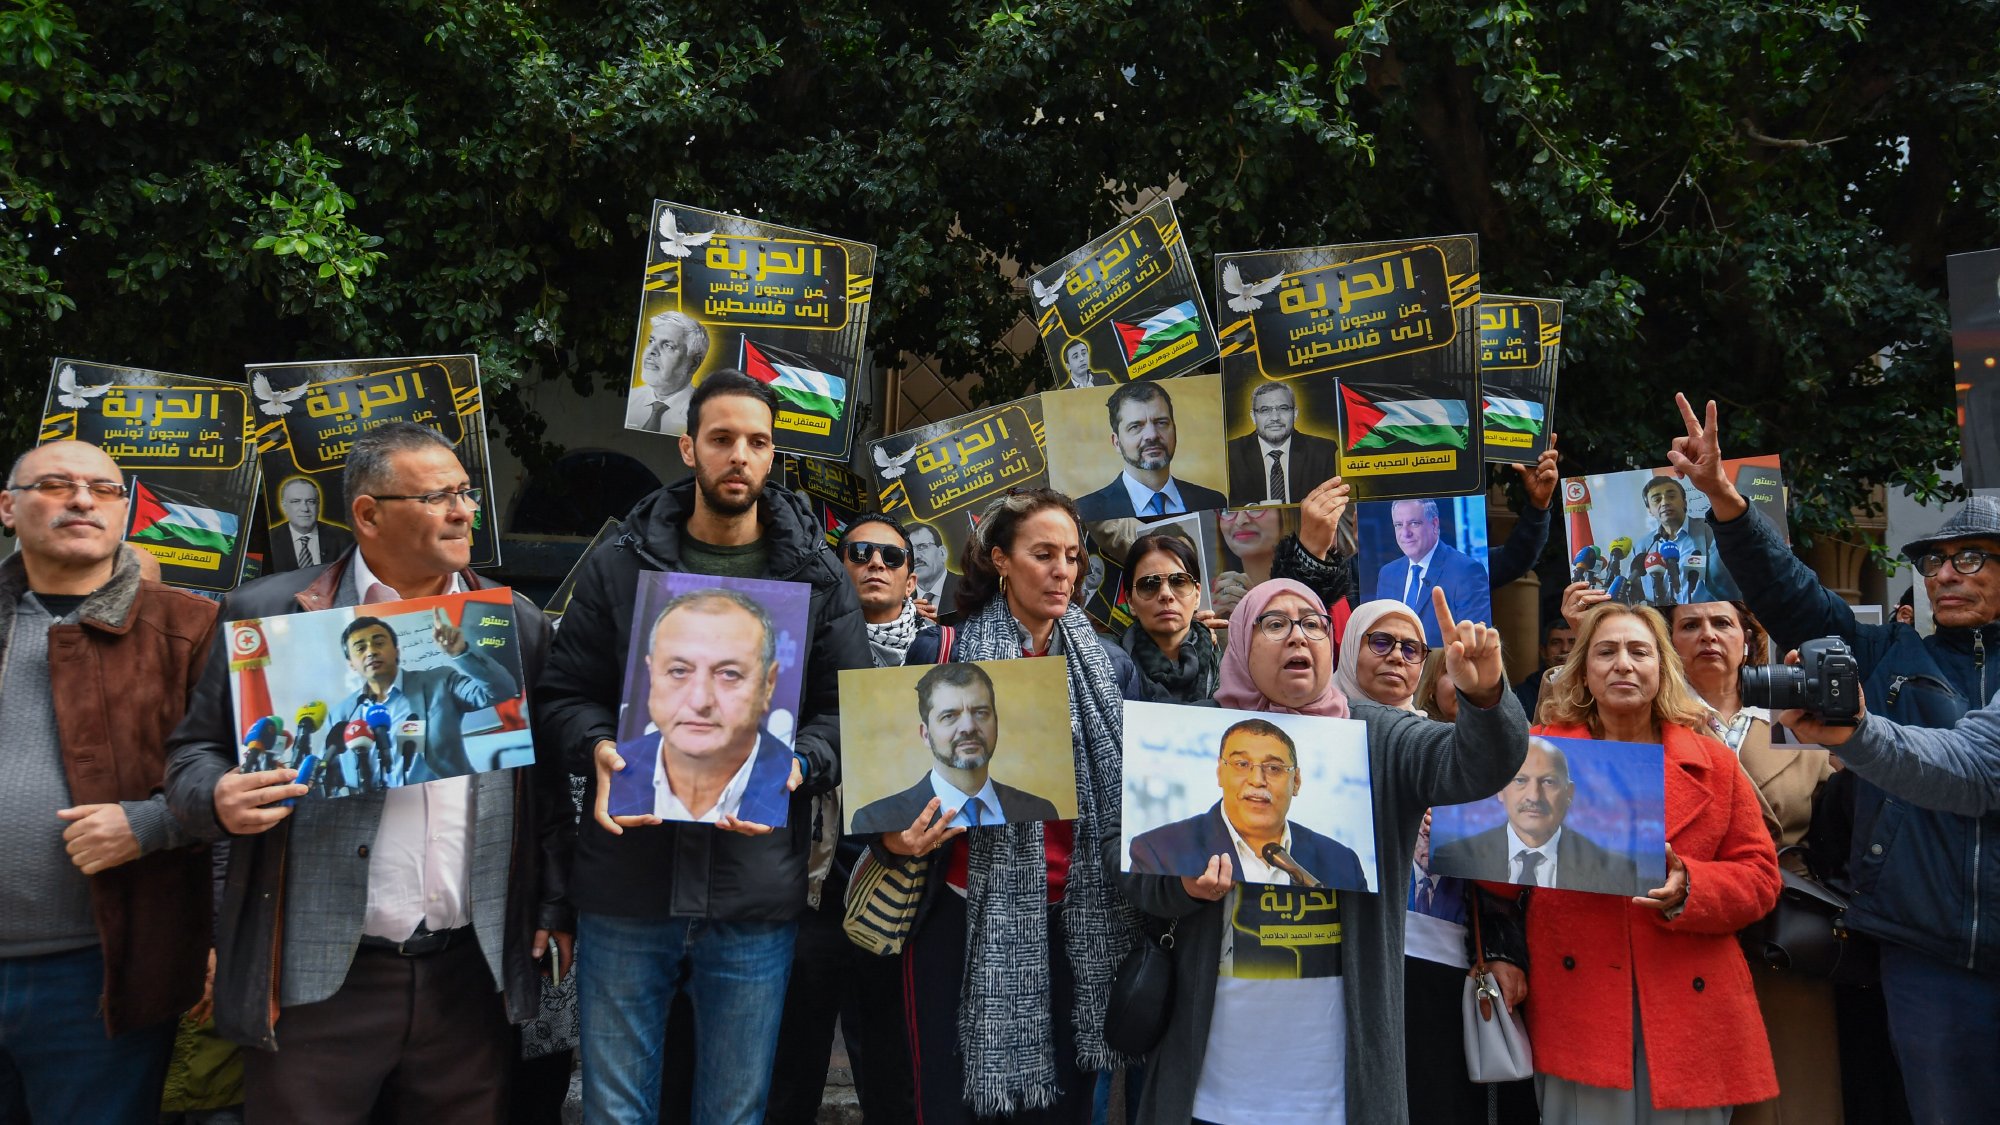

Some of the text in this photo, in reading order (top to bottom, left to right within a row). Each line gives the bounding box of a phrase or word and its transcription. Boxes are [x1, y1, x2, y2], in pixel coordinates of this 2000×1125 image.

[706, 239, 821, 282] الحرية
[1065, 229, 1142, 296] الحرية
[710, 281, 824, 298] من سجون تونس
[1077, 253, 1150, 309] من سجون تونس
[1079, 259, 1162, 325] إلى فلسطين
[1279, 257, 1415, 319] الحرية
[705, 295, 829, 323] إلى فلسطين
[1480, 308, 1520, 330] الح
[1289, 303, 1421, 341] من سجون تونس
[1287, 318, 1434, 367] إلى فلسطين
[1481, 336, 1522, 347] من سج
[1499, 348, 1527, 364] إلى
[306, 372, 426, 422] الحرية
[102, 390, 220, 427] الحرية
[412, 409, 433, 423] من
[317, 421, 359, 440] تونس
[794, 416, 826, 429] للمعتقل
[104, 427, 220, 441] من سجون تونس
[189, 444, 225, 463] إلى
[915, 417, 1010, 475] الحرية
[928, 447, 1018, 492] من سجون تونس
[1346, 454, 1451, 471] للمعتقل الصحبي عتيق
[929, 456, 1031, 510] إلى فلسطين
[1751, 476, 1777, 486] دستور
[1749, 493, 1773, 503] تونس
[177, 552, 212, 564] للمعتقل
[478, 615, 510, 627] دستور
[476, 636, 506, 648] تونس
[1260, 885, 1337, 922] لحرية
